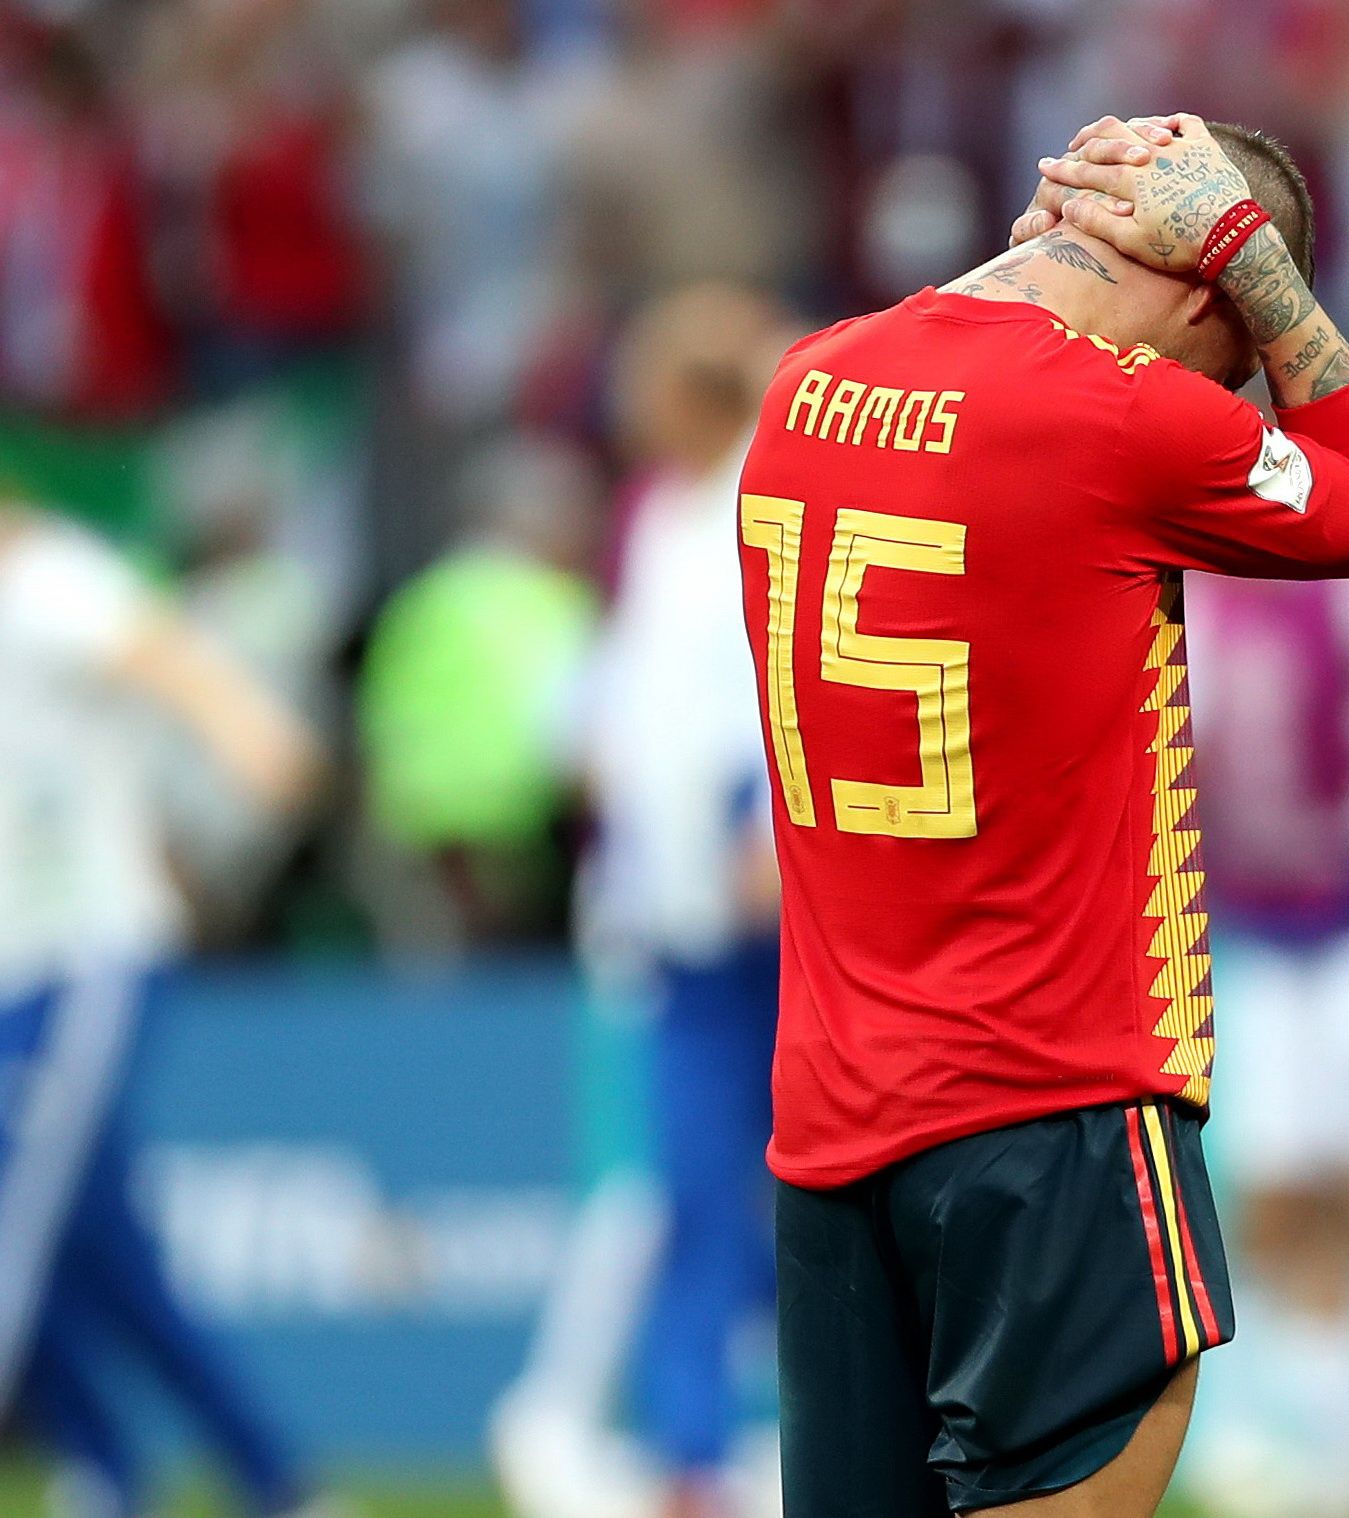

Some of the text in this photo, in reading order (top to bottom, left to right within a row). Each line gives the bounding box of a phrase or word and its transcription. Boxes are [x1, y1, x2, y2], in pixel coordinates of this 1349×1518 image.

[1281, 325, 1330, 380] HOPE
[786, 370, 965, 454] RAMOS
[740, 494, 978, 839] 15
